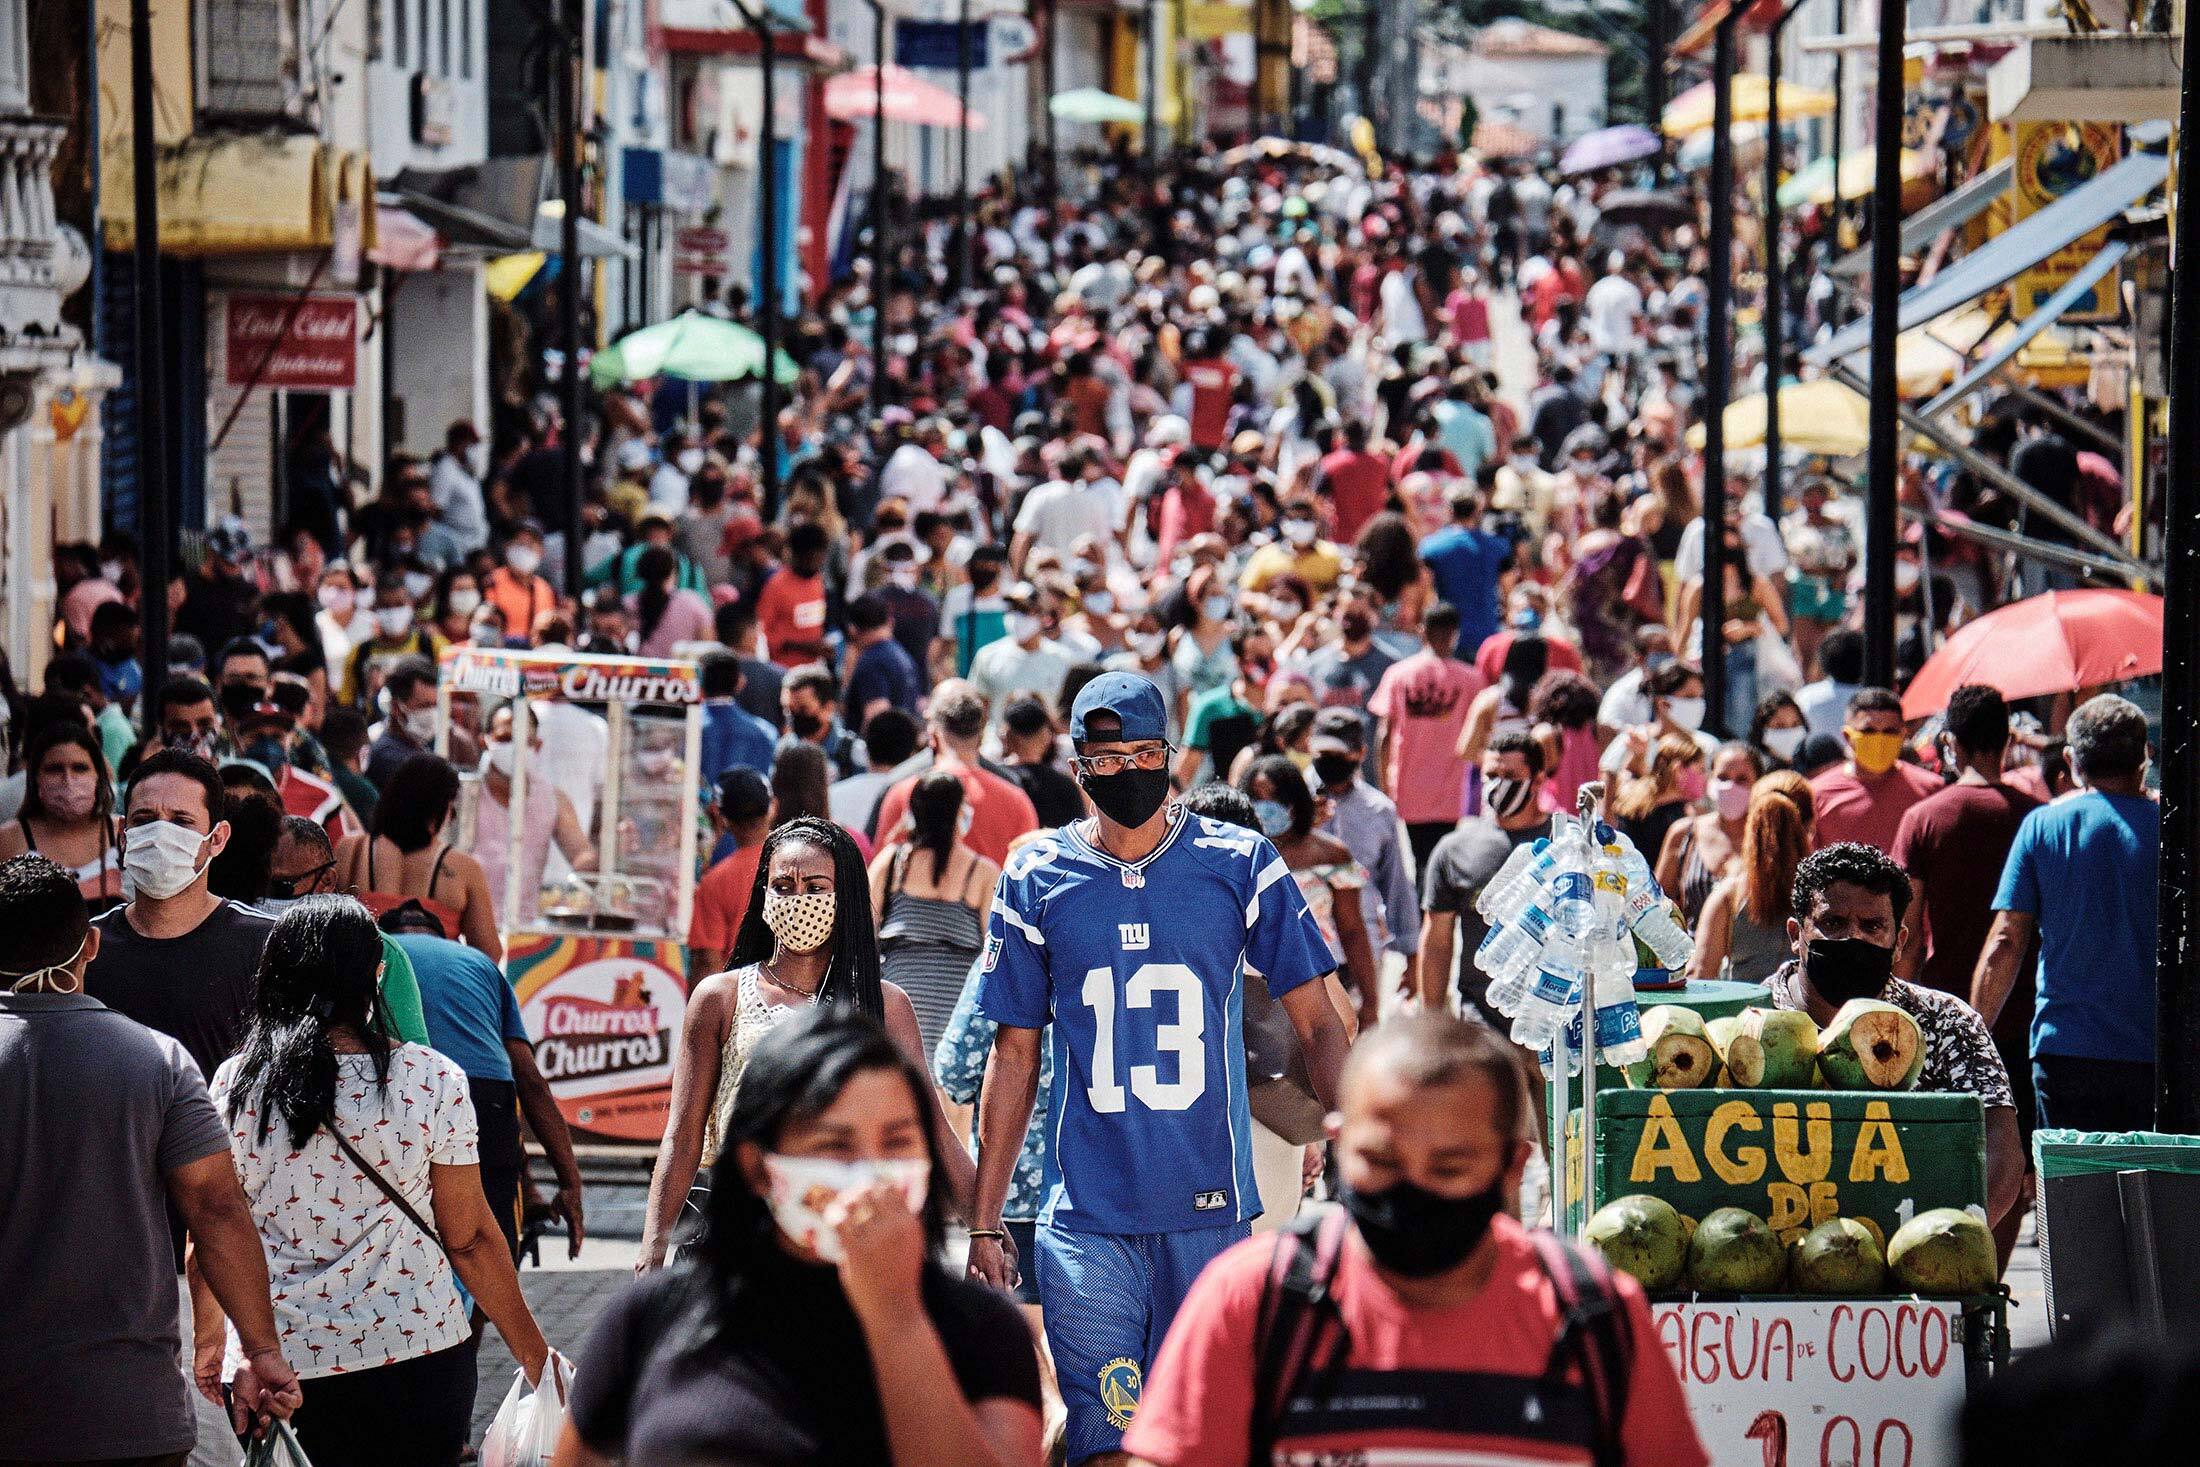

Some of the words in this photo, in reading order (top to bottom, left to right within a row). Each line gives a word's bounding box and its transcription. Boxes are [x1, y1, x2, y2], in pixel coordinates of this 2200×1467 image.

[563, 666, 700, 702] Churros
[551, 1003, 656, 1036] Churros
[1081, 964, 1206, 1113] 13
[536, 1034, 662, 1079] Churros
[1766, 1182, 1839, 1229] DE
[1657, 1304, 1794, 1384] ÁGUA
[1796, 1342, 1818, 1359] DE
[1827, 1304, 1949, 1384] COCO
[1126, 1375, 1138, 1390] 30
